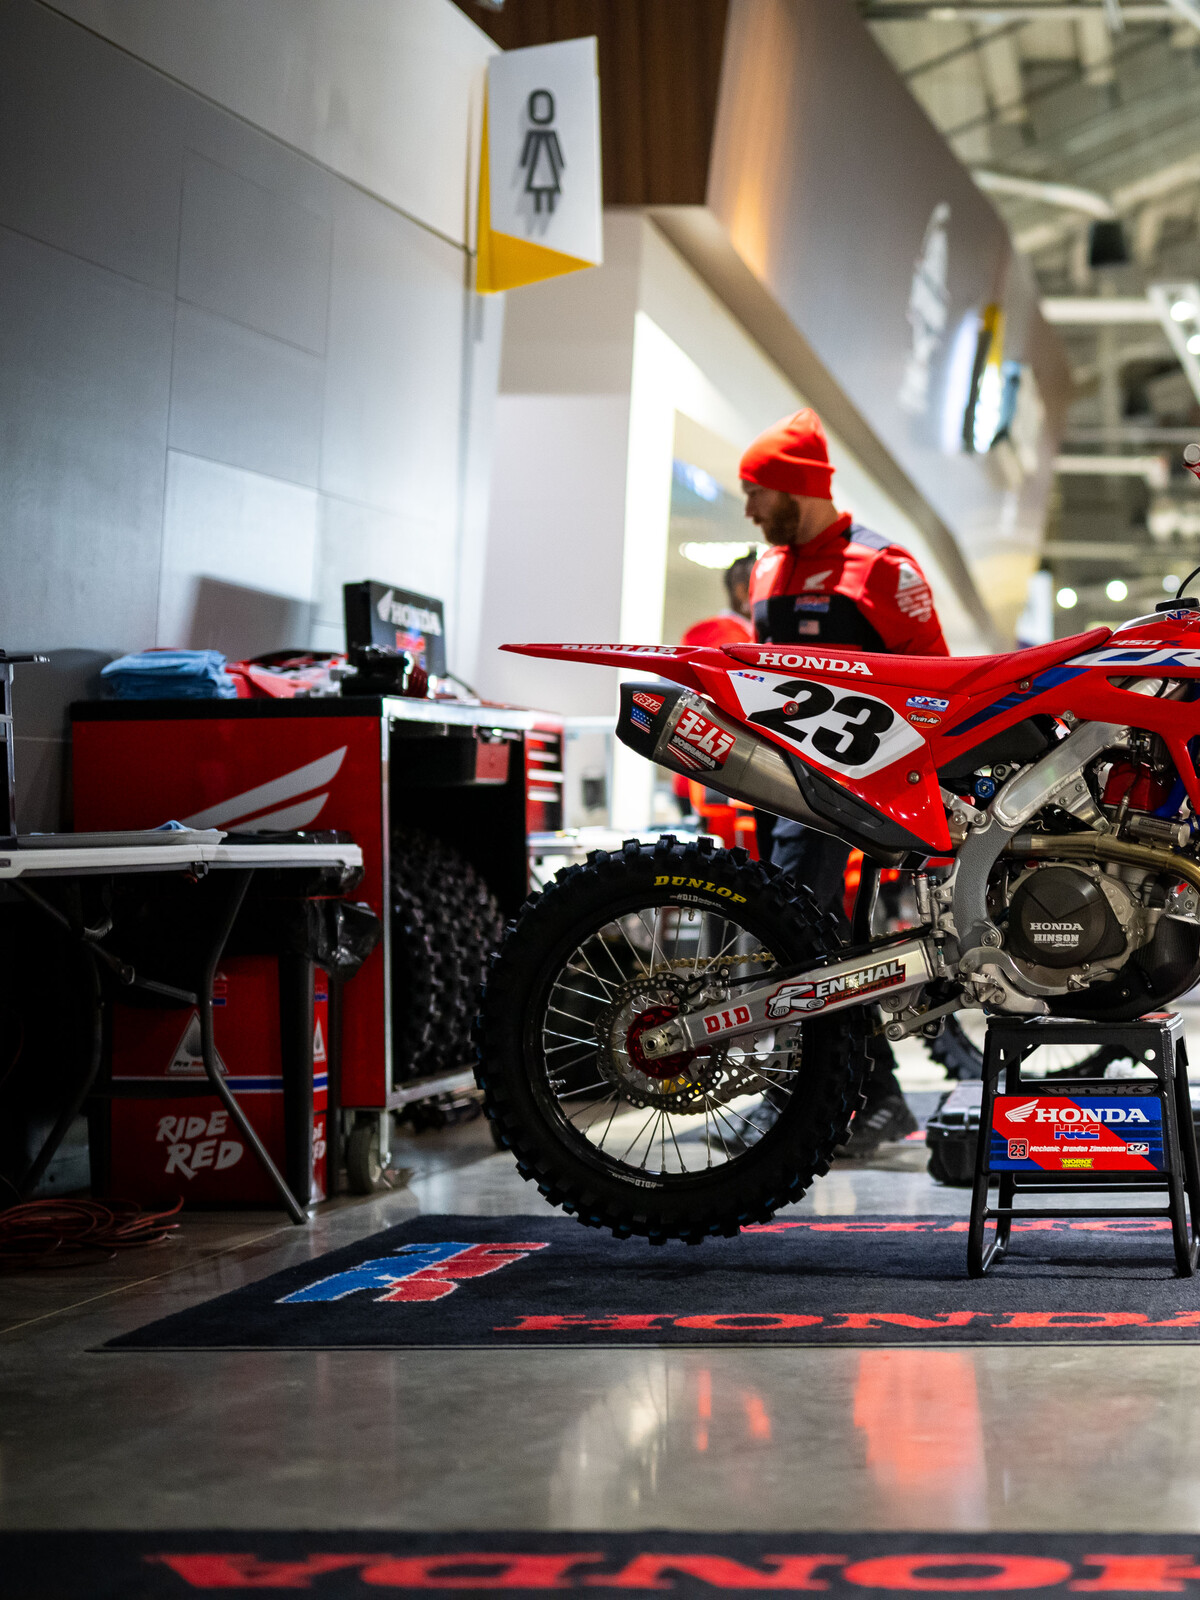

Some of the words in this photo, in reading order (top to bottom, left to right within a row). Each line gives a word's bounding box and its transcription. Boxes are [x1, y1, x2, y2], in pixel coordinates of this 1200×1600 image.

[757, 652, 873, 676] HONDA
[747, 680, 895, 765] 23
[910, 714, 928, 723] Twin
[675, 710, 734, 758] ヨシムラ
[654, 875, 748, 904] DUNLOP
[1030, 922, 1084, 931] HONDA
[1033, 933, 1080, 942] HINSON
[704, 1006, 750, 1034] D.I.D
[155, 1110, 229, 1143] RIDE
[1035, 1108, 1150, 1123] HONDA
[1054, 1123, 1100, 1140] HRC
[164, 1139, 244, 1181] RED
[1010, 1144, 1026, 1156] 23
